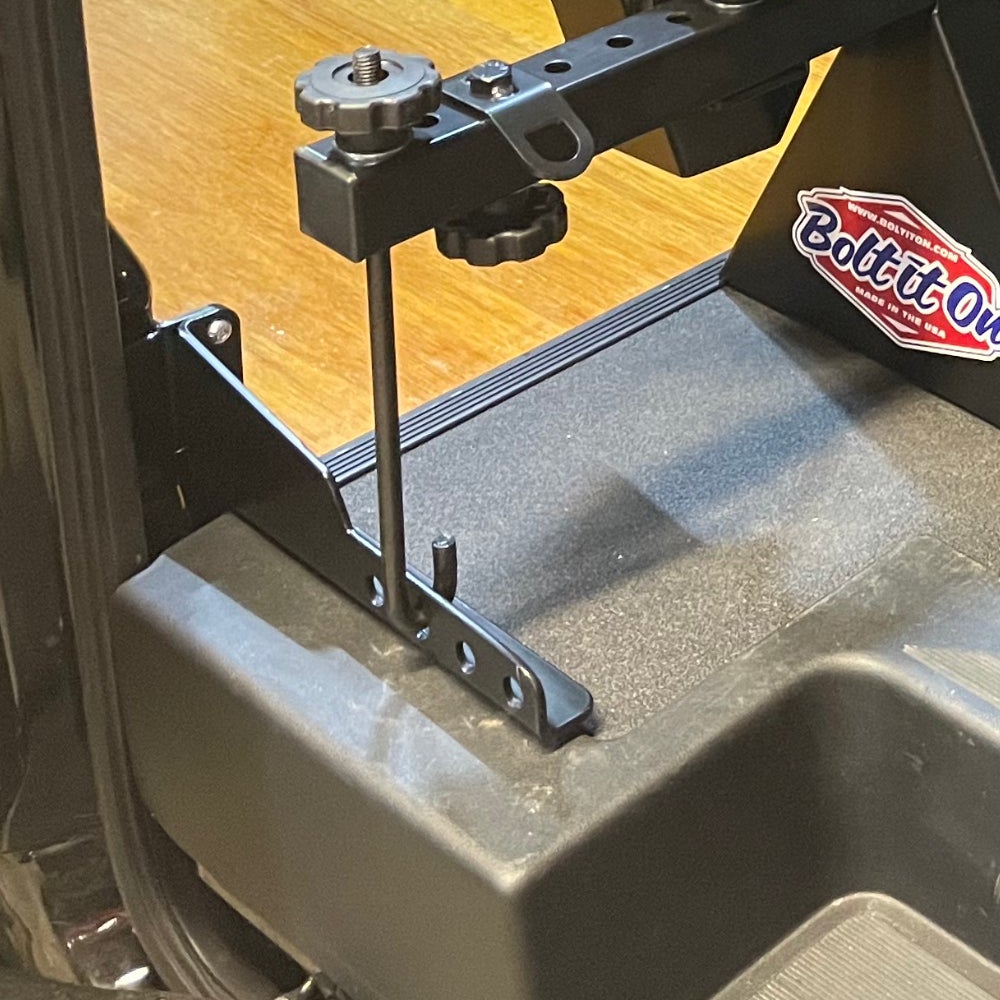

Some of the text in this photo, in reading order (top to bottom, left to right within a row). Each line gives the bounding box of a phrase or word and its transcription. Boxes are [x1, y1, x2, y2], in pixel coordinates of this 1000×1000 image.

[800, 201, 901, 286] Bolt
[896, 255, 946, 310] it
[847, 201, 959, 264] WWW.BOLTITON.COM
[854, 286, 947, 339] MADE IN THE USA
